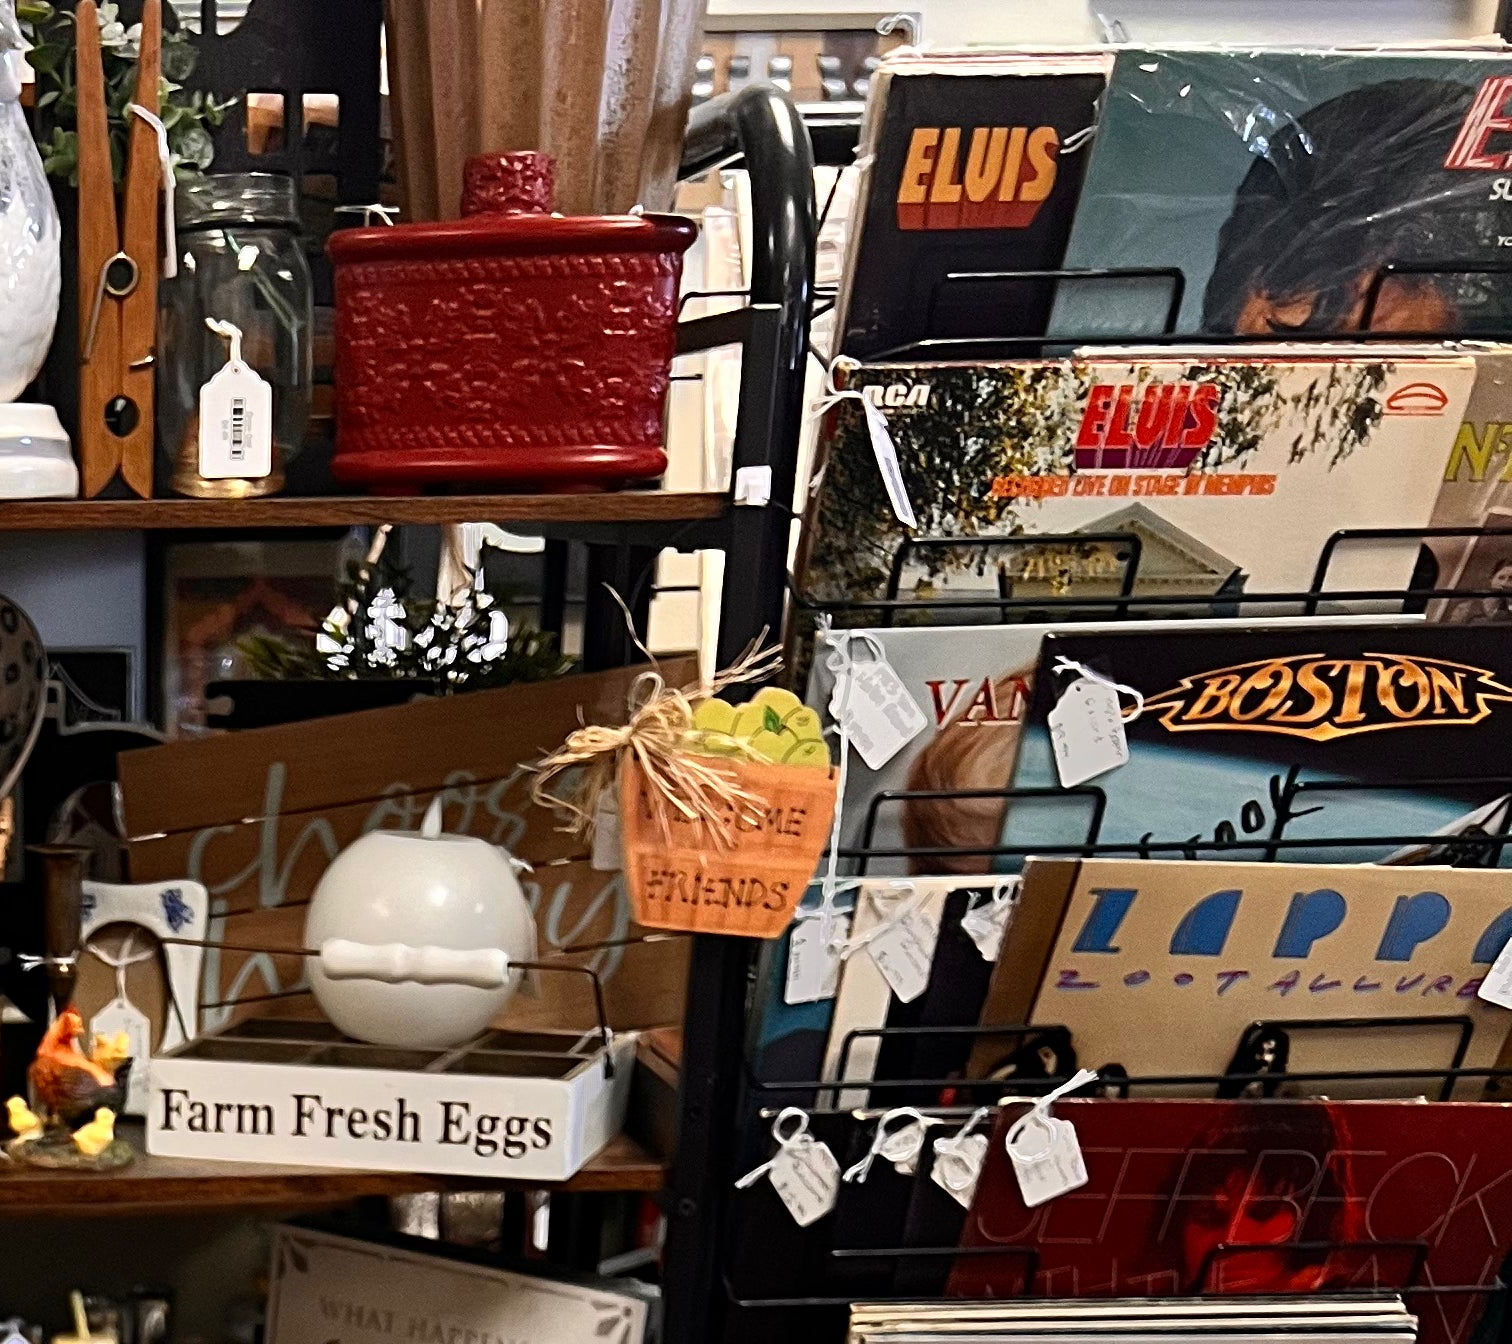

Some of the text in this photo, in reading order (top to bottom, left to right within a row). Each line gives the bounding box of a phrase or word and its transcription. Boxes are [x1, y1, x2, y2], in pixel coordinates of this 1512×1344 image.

[897, 126, 1060, 230] ELVIS
[862, 384, 931, 408] RCA
[1075, 384, 1221, 469] ELVIS
[1182, 660, 1470, 725] BOSTON
[1055, 969, 1249, 996] ZOOT
[160, 1087, 554, 1159] Farm Fresh Eggs
